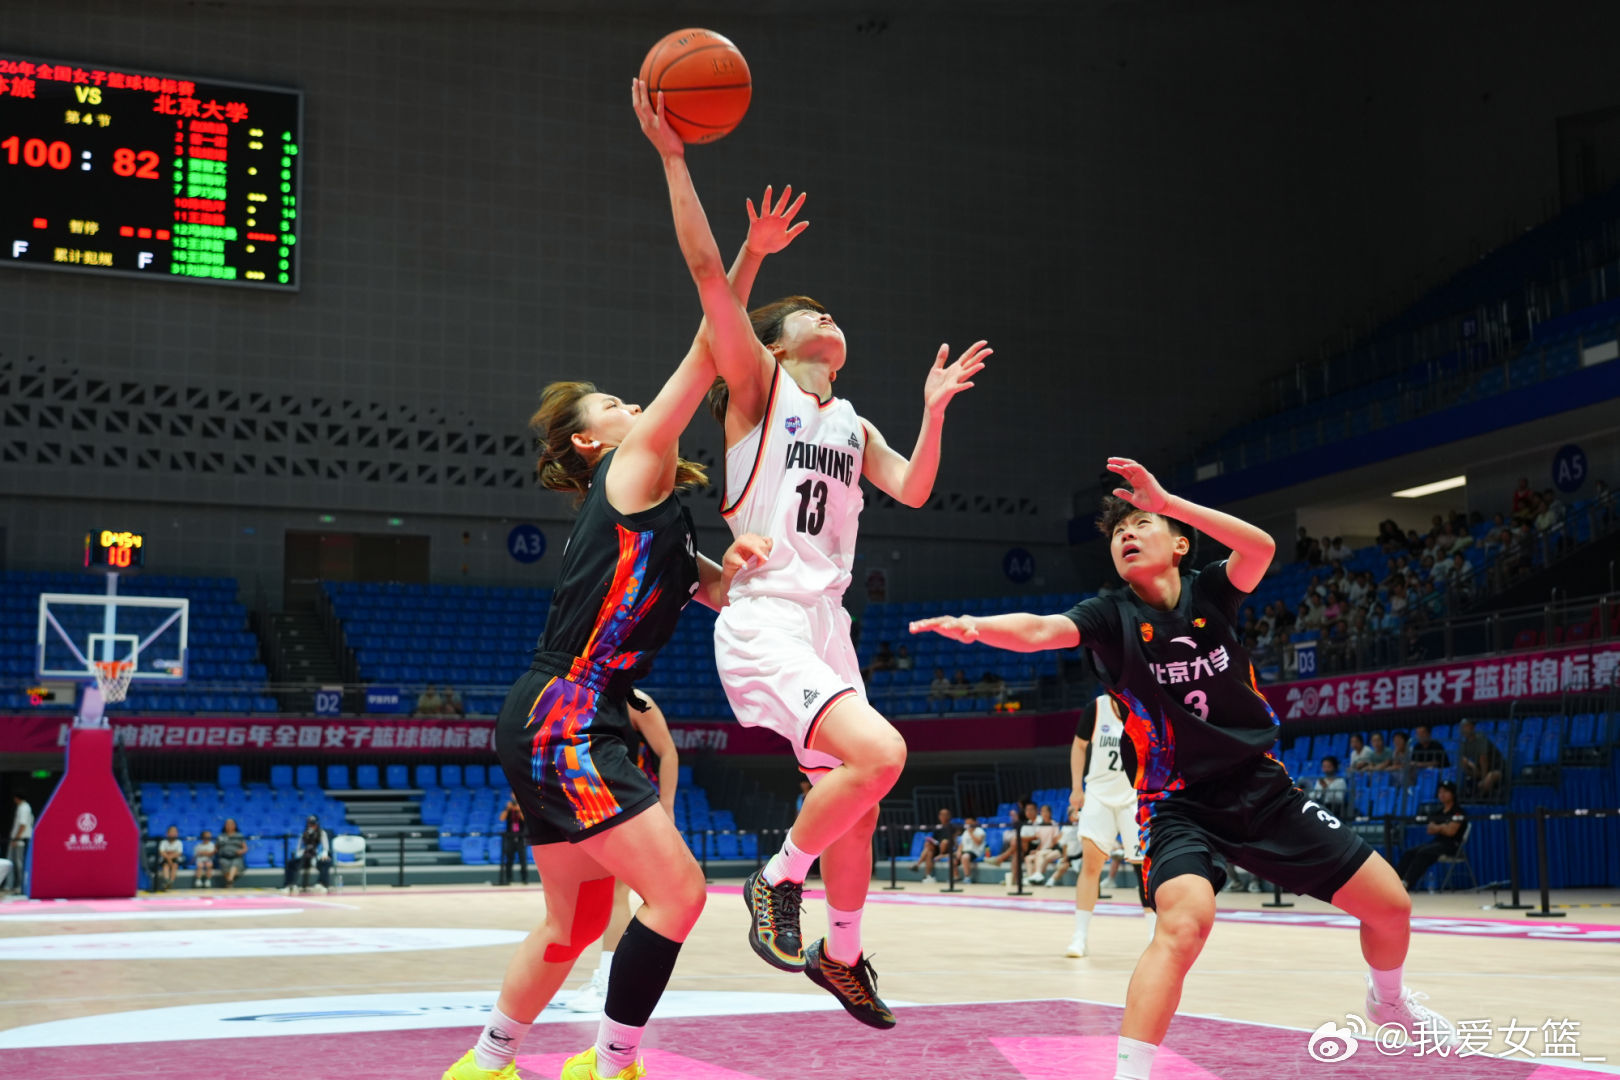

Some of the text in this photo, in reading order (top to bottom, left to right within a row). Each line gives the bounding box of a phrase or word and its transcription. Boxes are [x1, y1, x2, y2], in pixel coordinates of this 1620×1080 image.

[74, 85, 102, 105] VS
[153, 94, 248, 123] 北京大学
[1, 136, 71, 170] 100
[112, 148, 159, 179] 82
[12, 240, 29, 258] F
[138, 251, 153, 269] F
[1558, 455, 1582, 484] A5
[796, 479, 828, 536] 13
[513, 534, 541, 554] A3
[108, 547, 131, 567] 10
[1009, 557, 1032, 575] A4
[1149, 645, 1230, 684] 北京大学
[1300, 652, 1316, 673] D3
[1286, 651, 1620, 719] 2026年全国女子篮球锦标赛
[316, 693, 339, 712] D2
[1184, 689, 1209, 722] 3
[1317, 810, 1341, 829] 3
